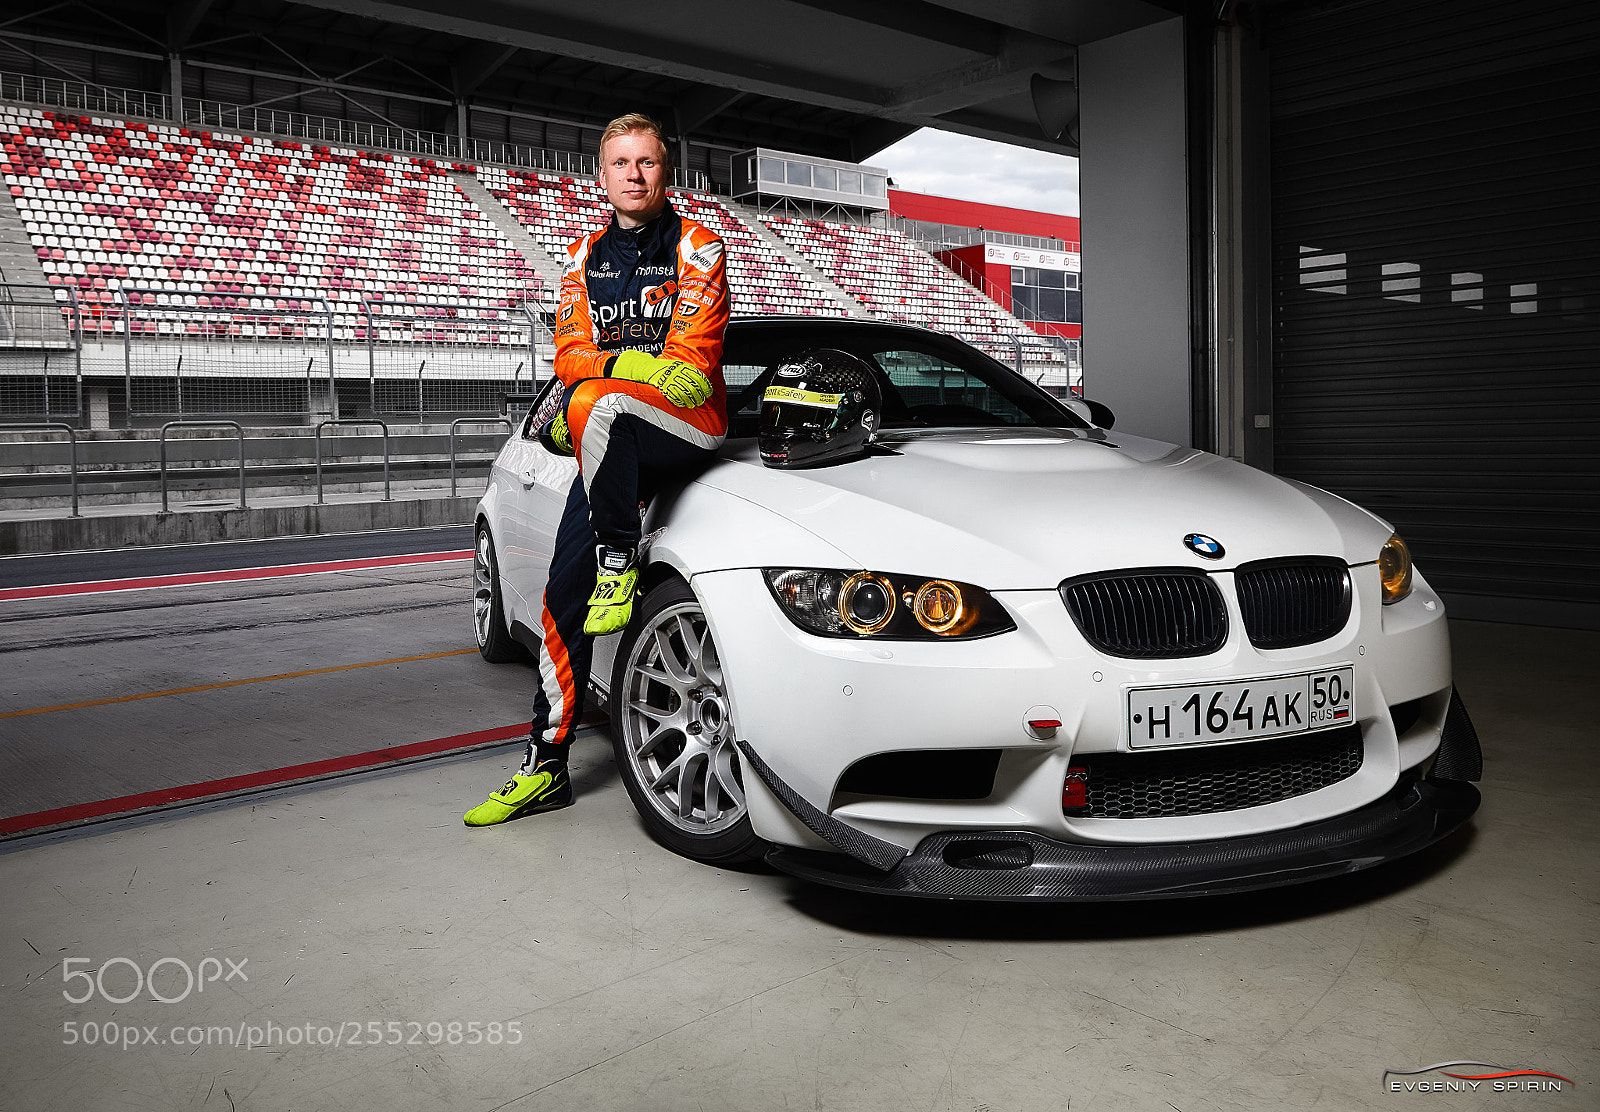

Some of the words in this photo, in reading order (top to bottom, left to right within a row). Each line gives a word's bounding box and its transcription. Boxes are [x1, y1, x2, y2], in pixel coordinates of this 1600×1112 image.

[635, 265, 675, 277] monsta
[1312, 674, 1343, 709] 50
[1311, 708, 1333, 723] RUS
